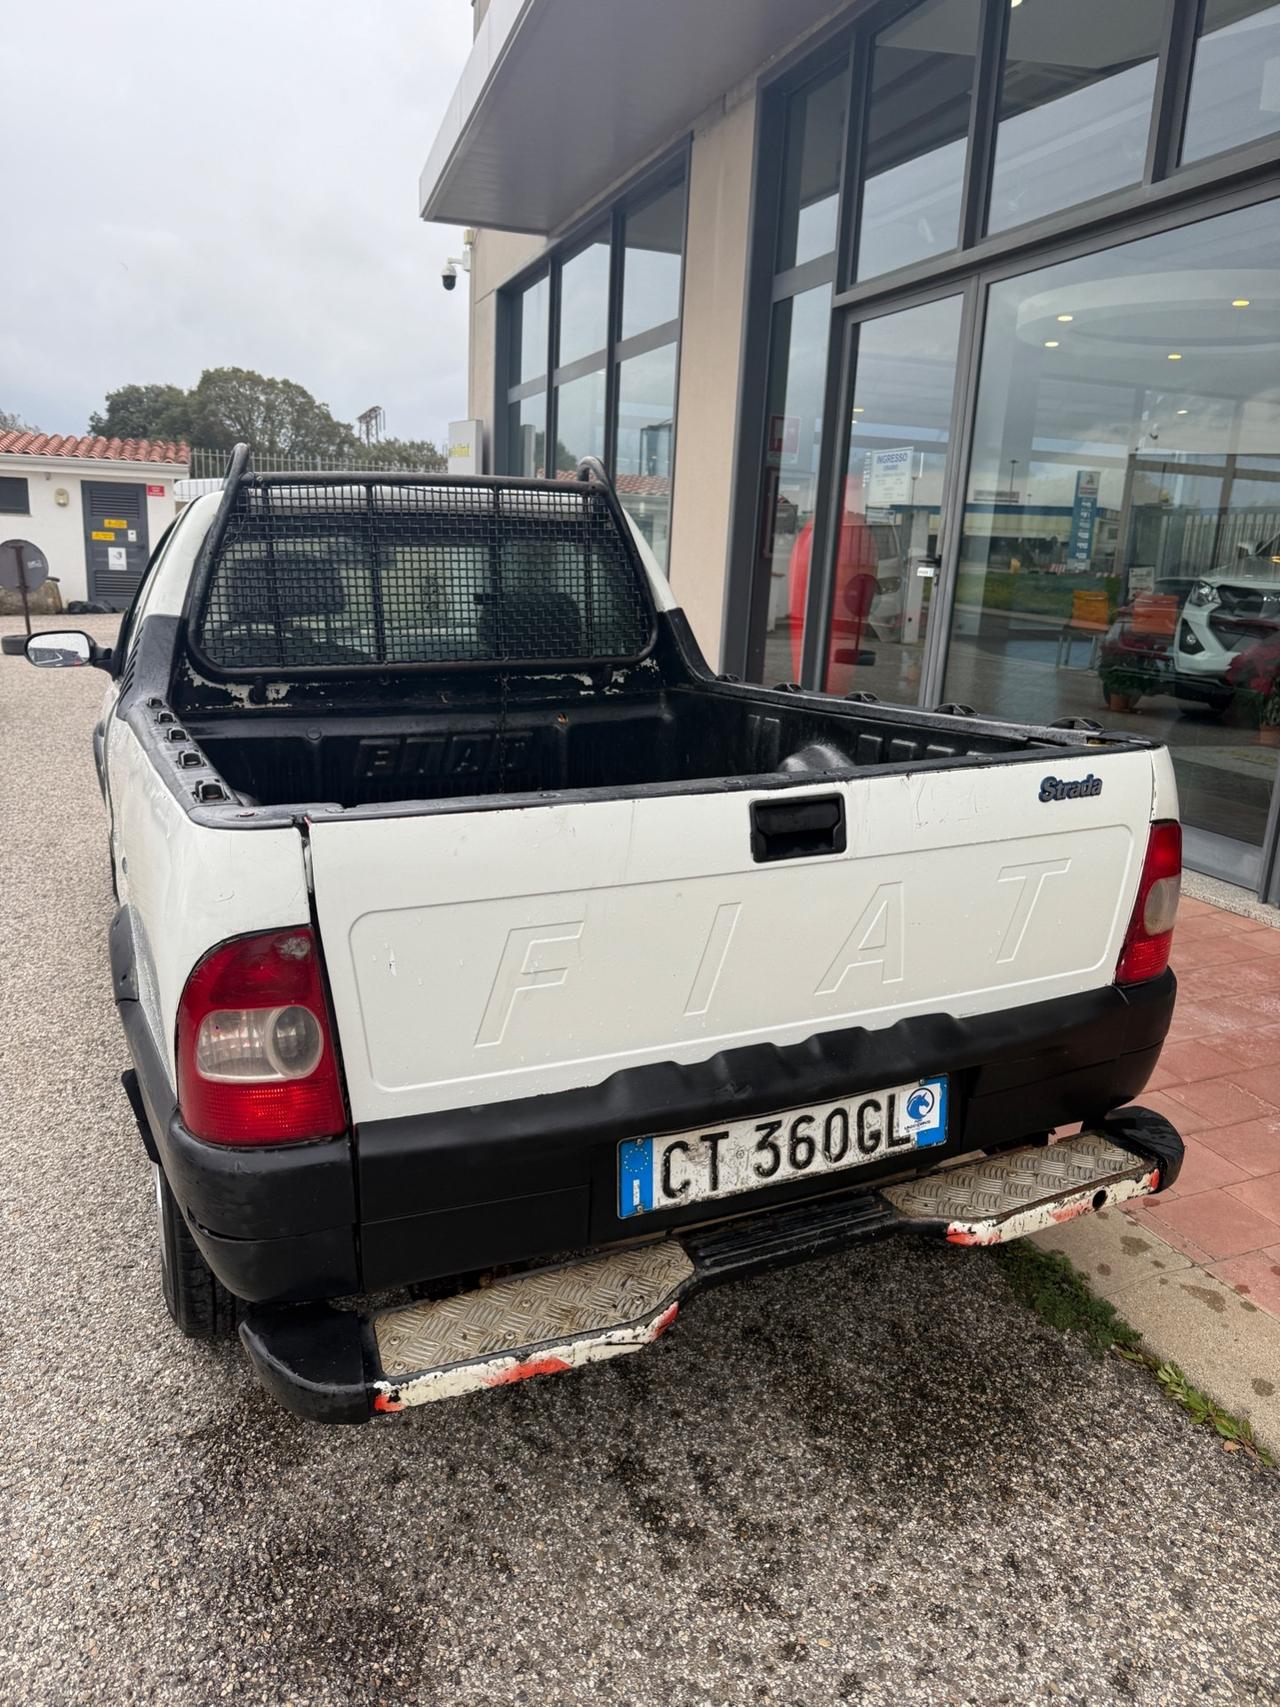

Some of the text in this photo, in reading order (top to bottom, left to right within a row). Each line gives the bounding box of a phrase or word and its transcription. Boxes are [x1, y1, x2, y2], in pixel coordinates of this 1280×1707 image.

[876, 452, 908, 464] INGRESSO
[1038, 773, 1103, 803] Strada
[474, 857, 1072, 1049] FIAT
[661, 1131, 729, 1199] CT
